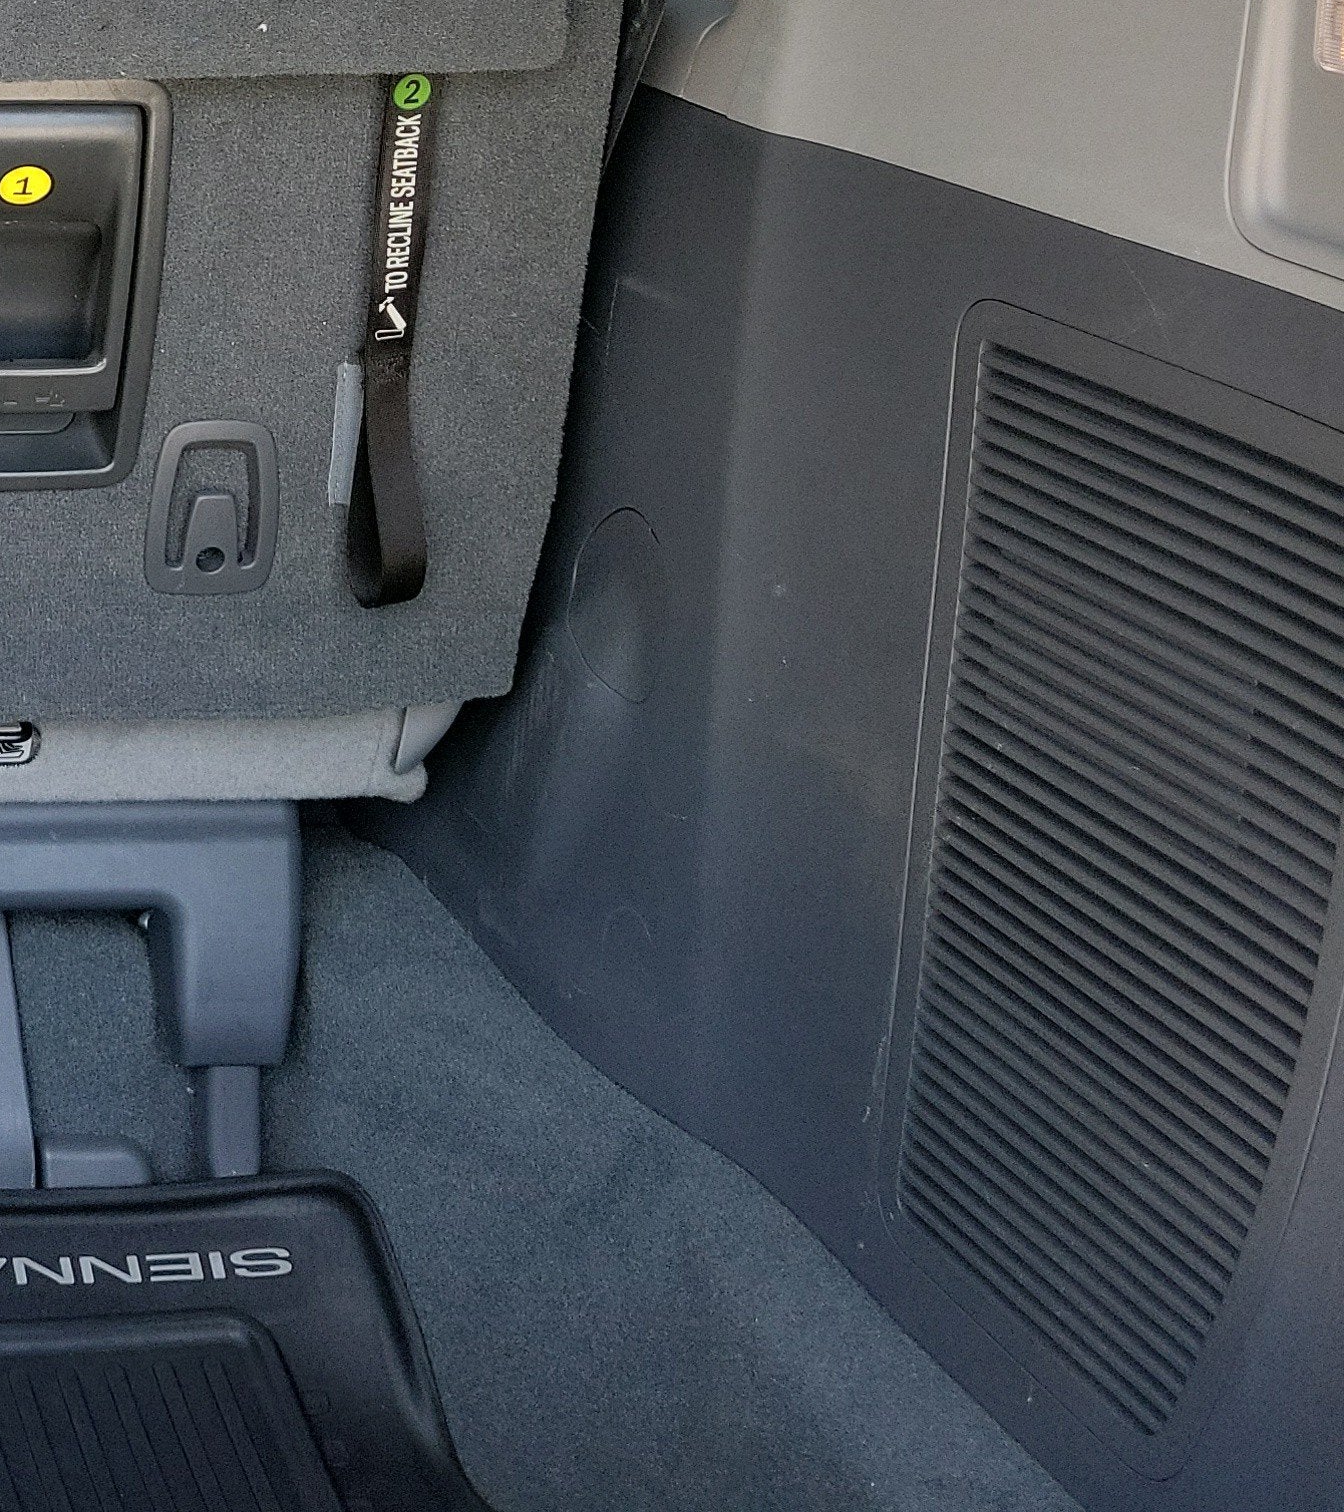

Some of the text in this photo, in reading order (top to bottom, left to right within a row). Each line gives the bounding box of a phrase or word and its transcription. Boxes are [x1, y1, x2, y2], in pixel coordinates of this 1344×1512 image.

[403, 79, 421, 105] 2
[12, 176, 32, 195] 1
[385, 113, 422, 294] TO RECLINE SEATBACK
